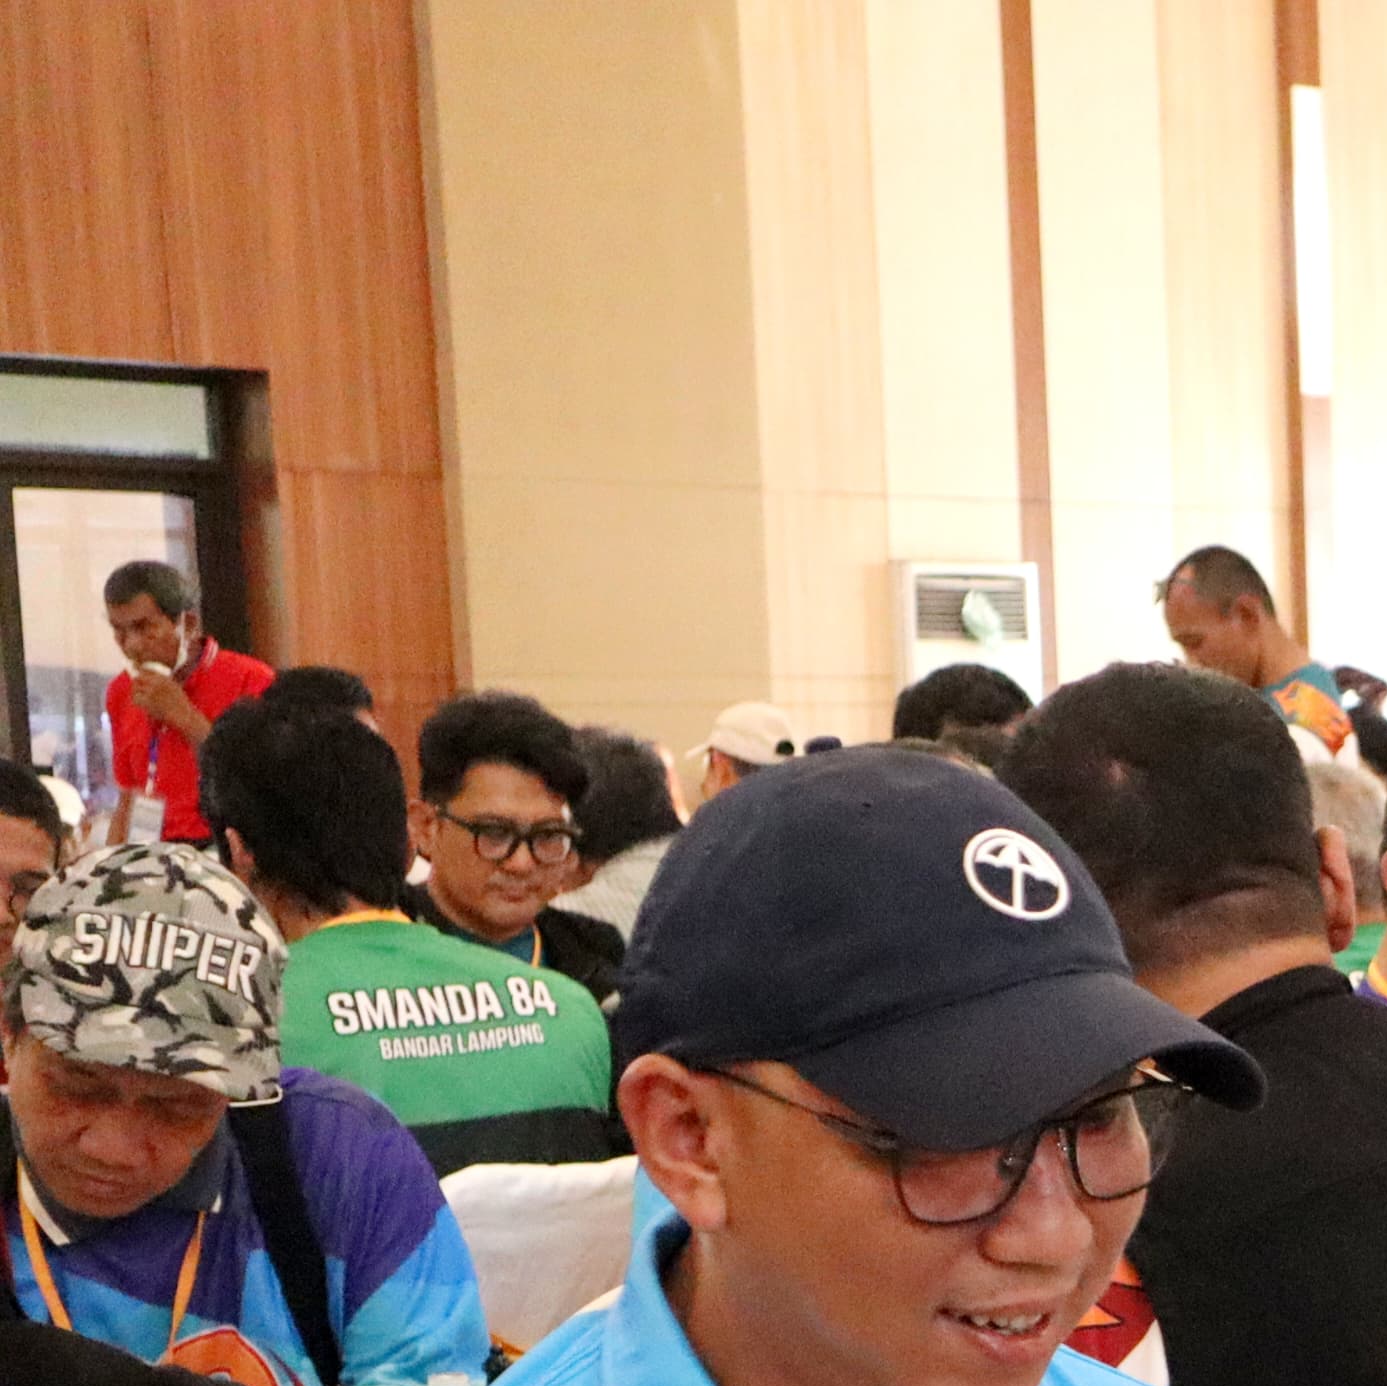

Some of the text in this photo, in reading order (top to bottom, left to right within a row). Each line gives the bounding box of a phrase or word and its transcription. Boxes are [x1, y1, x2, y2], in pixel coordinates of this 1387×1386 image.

[71, 911, 263, 1004] SNIPER
[327, 975, 557, 1035] SMANDA 84
[379, 1022, 545, 1061] BANDAR LAMPUNG
